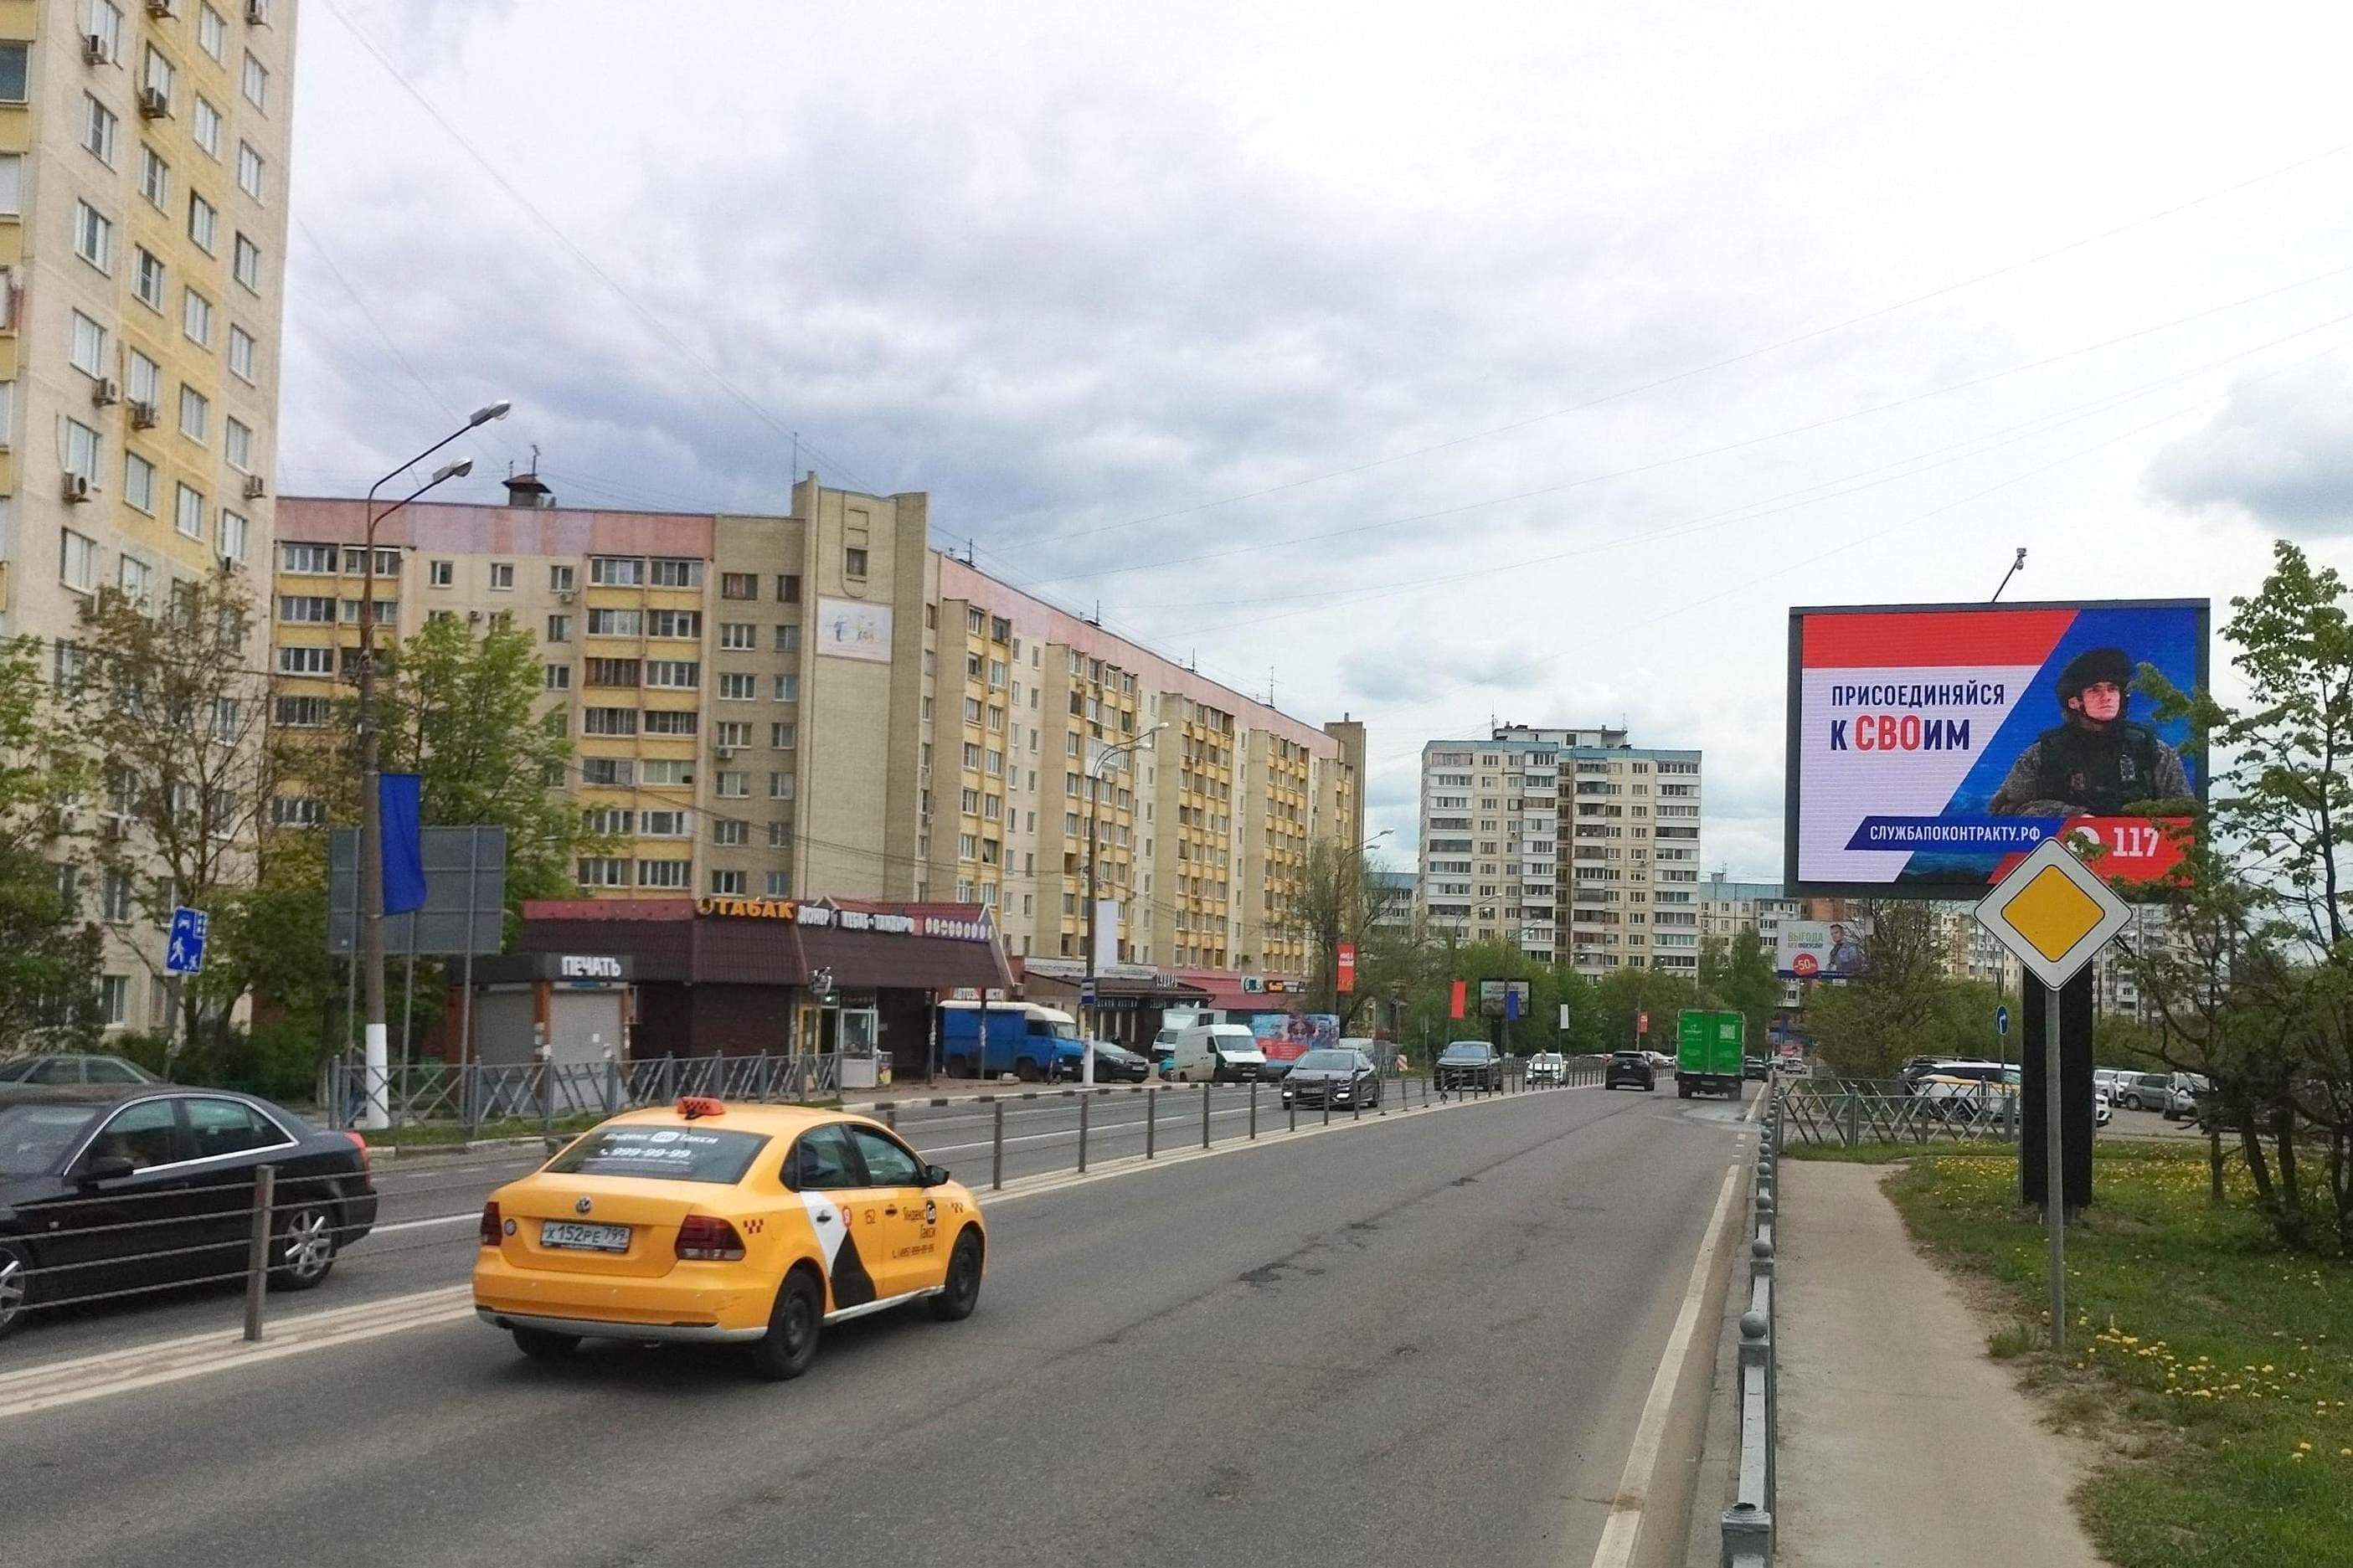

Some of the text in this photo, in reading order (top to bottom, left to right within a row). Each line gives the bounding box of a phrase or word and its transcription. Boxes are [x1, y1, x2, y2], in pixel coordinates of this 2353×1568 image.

[1831, 679, 2005, 708] ПРИСОЕДИНЯЙСЯ
[1830, 714, 1969, 751] К СВОИМ
[1870, 825, 2041, 841] СЛУЖБАПОКОНТРАКТУ.РФ
[2113, 827, 2159, 857] 117
[714, 897, 795, 918] ТАБАК
[562, 956, 621, 977] ПЕЧАТЬ
[611, 1147, 692, 1158] 999-99-99
